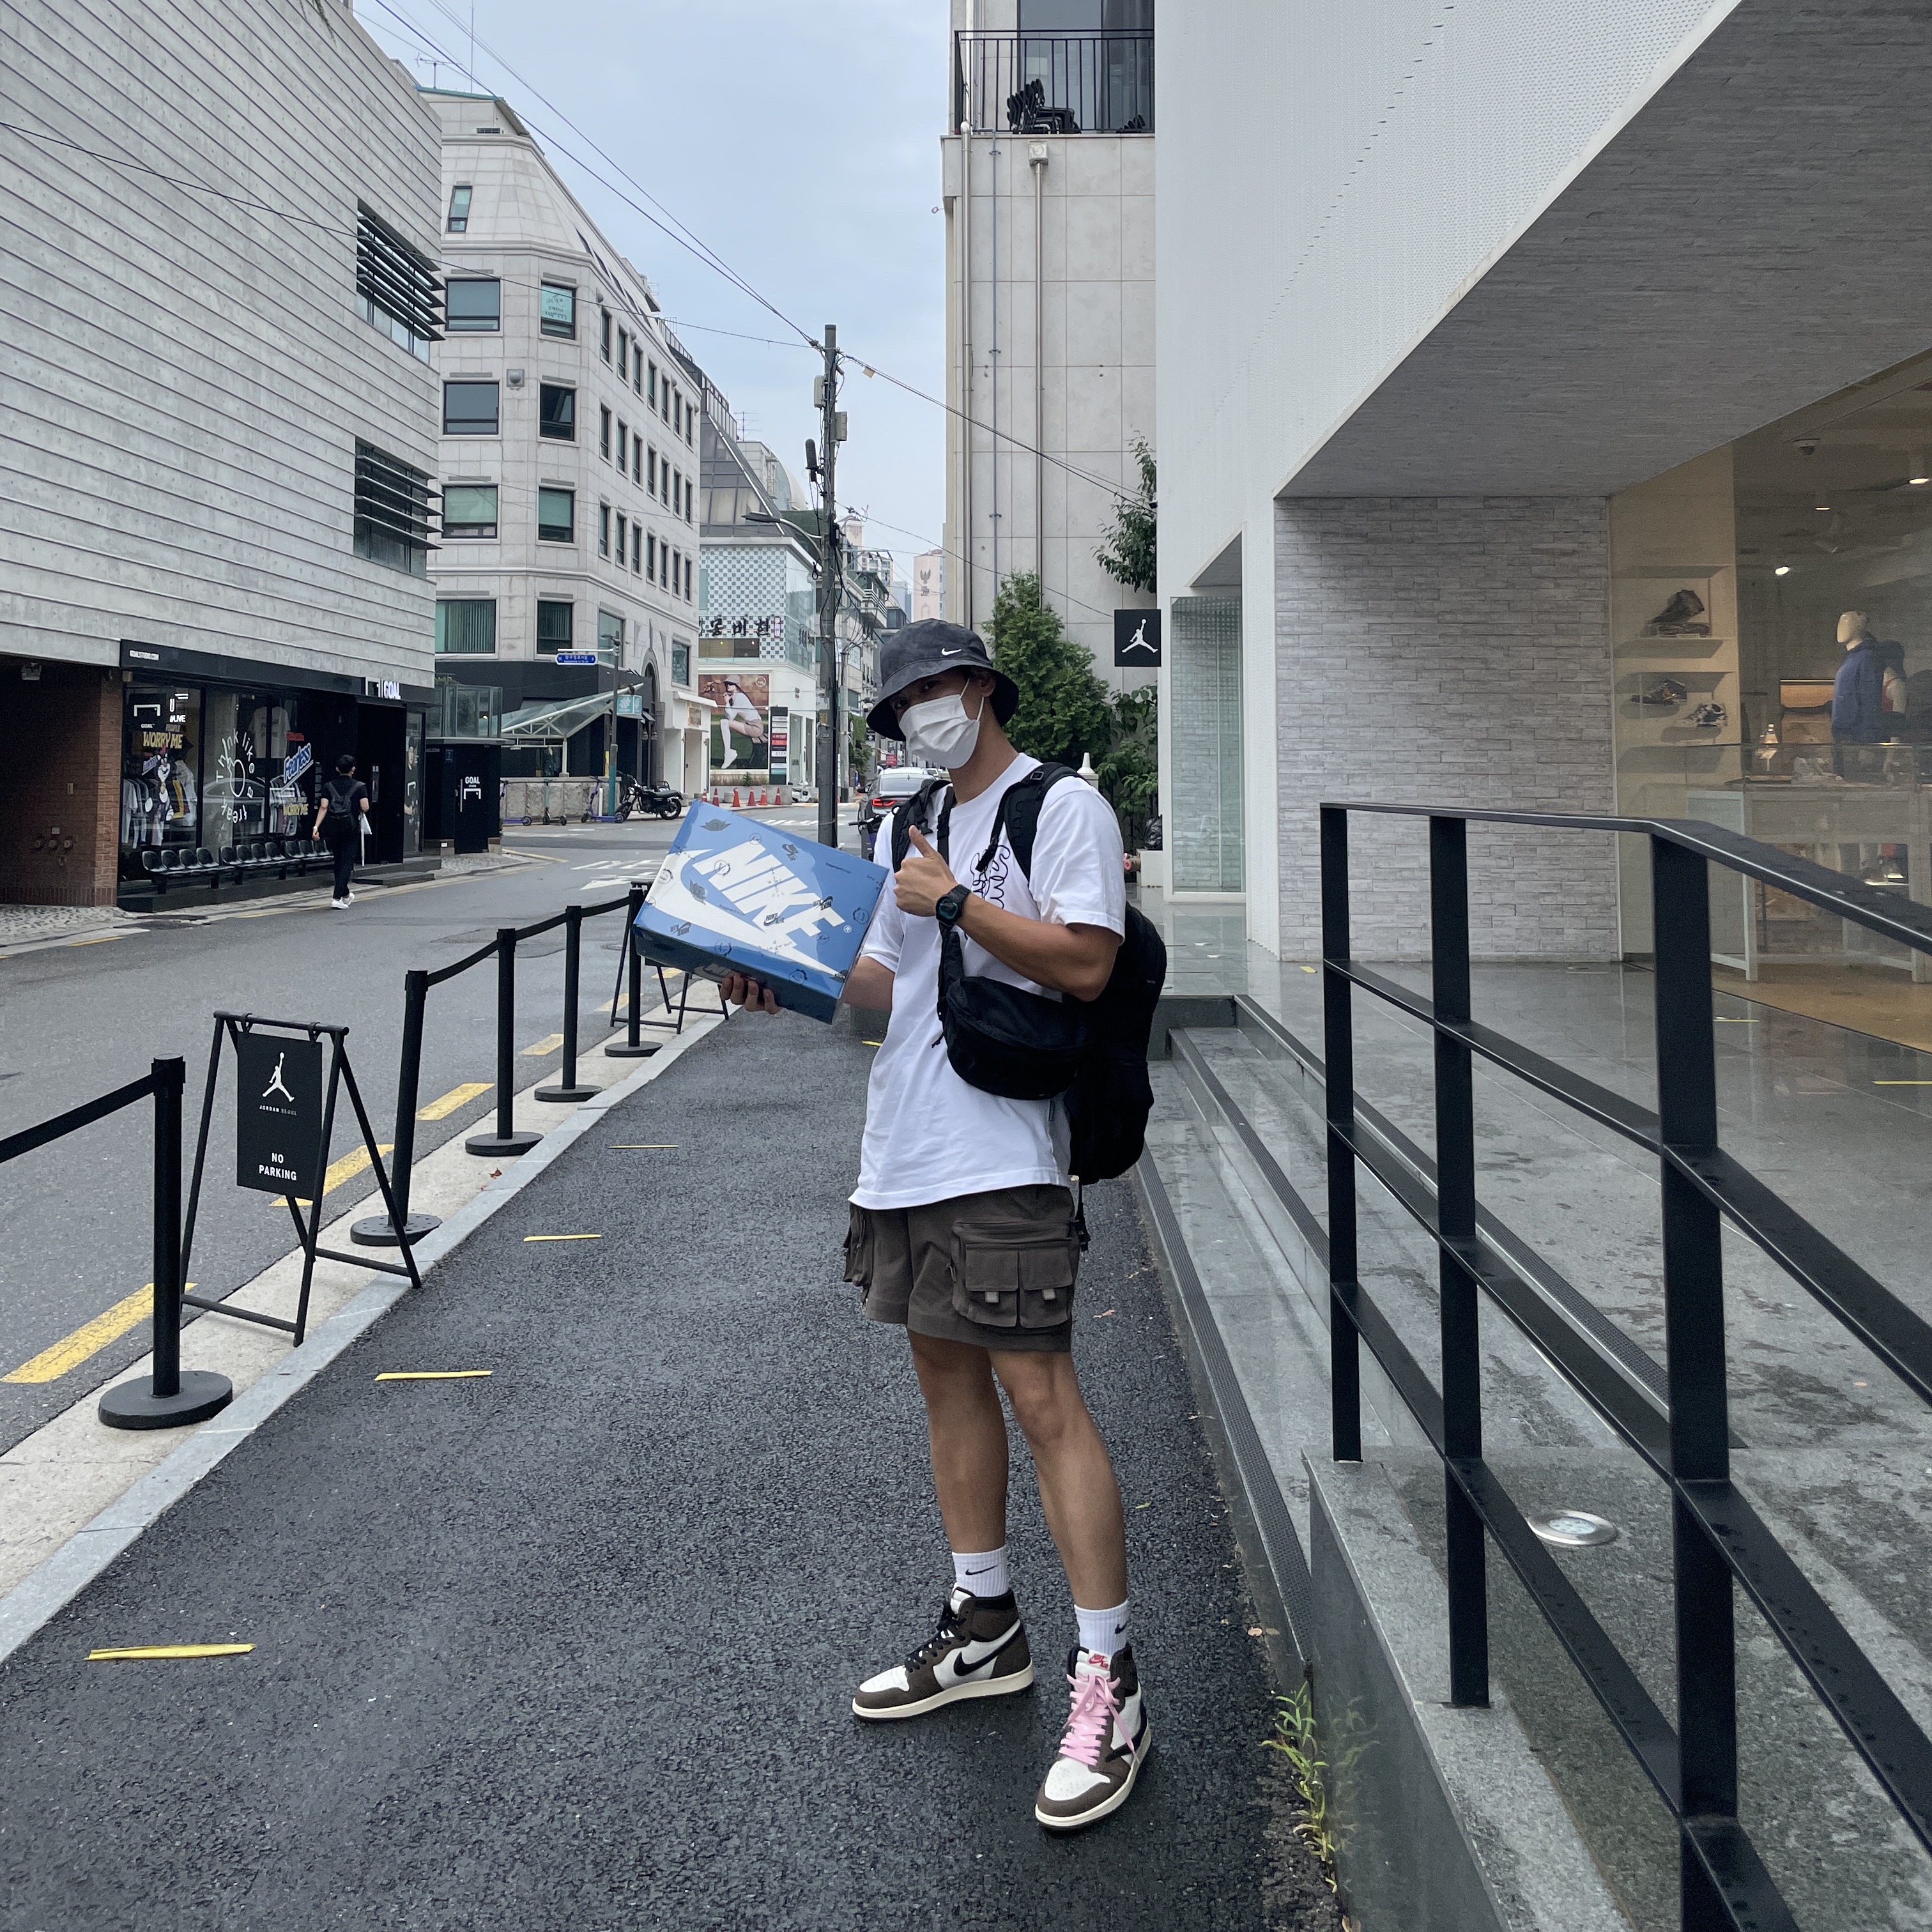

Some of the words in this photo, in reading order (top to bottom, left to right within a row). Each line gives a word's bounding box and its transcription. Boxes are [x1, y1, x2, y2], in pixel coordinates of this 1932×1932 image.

[384, 680, 401, 700] GOAL
[143, 732, 171, 747] WORRY
[170, 734, 183, 749] ME
[691, 840, 846, 946] NIKE
[272, 1152, 284, 1163] NO
[259, 1165, 297, 1181] PARKING
